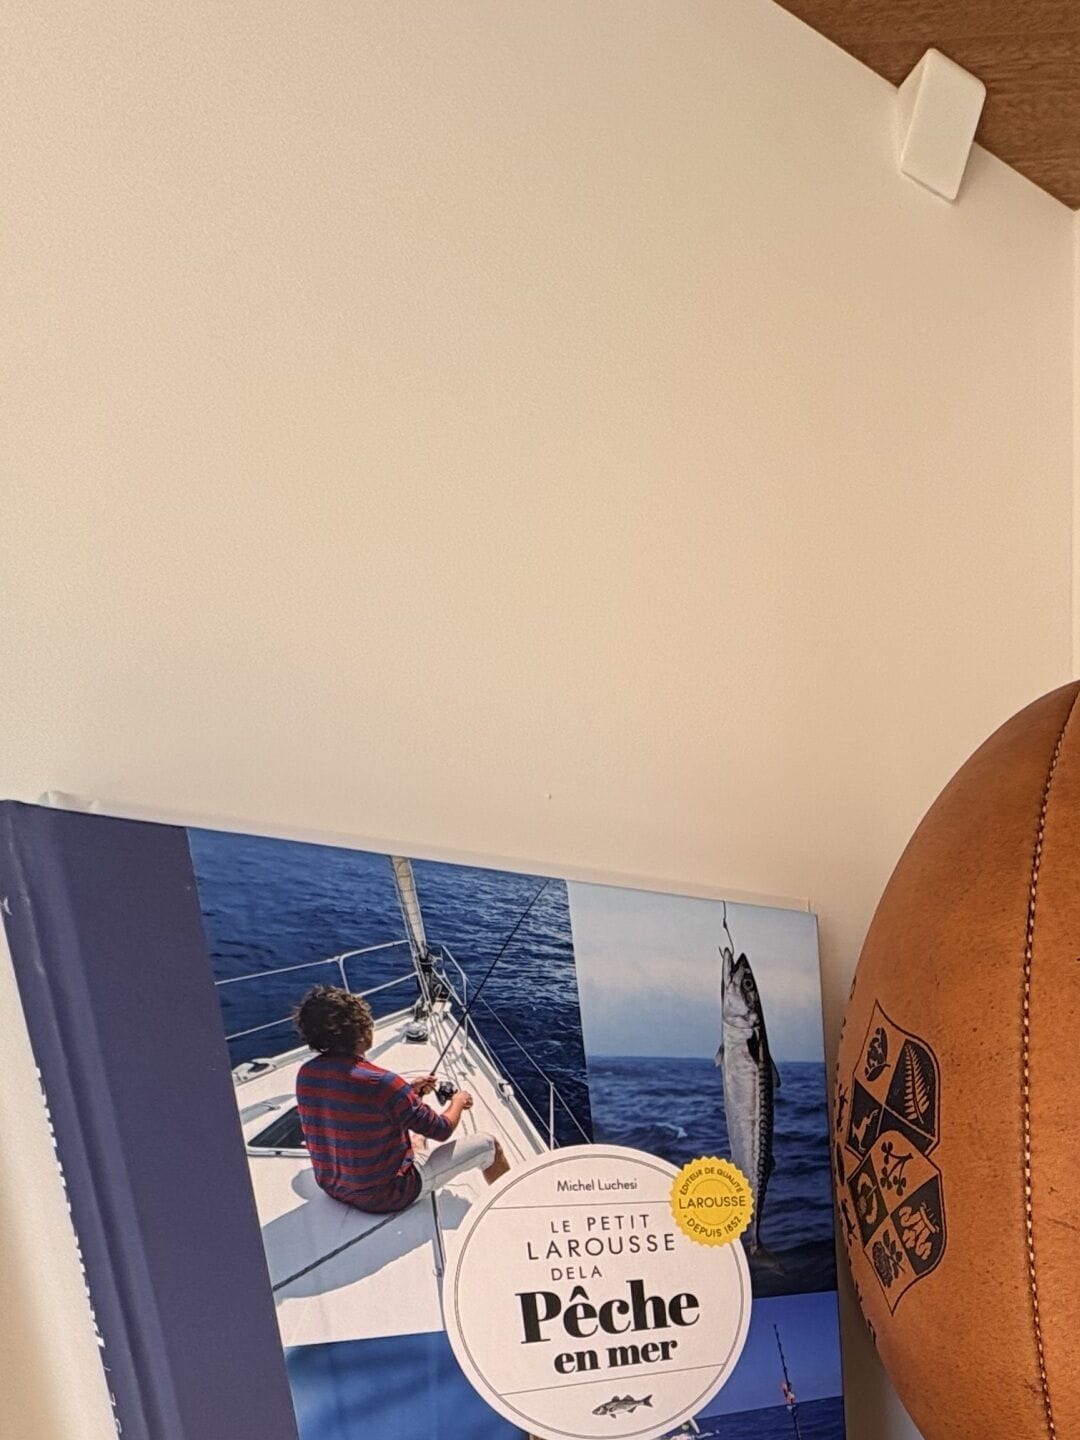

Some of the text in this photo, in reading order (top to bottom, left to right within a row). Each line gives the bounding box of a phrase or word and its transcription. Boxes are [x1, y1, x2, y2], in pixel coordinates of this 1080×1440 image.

[705, 1166, 715, 1175] DE
[556, 1178, 638, 1192] Michel Luchesi
[678, 1195, 747, 1210] LAROUSSE
[550, 1214, 650, 1234] LE PETIT
[686, 1215, 742, 1238] DEPUIS 1852
[527, 1233, 676, 1260] LAROUSSE
[515, 1279, 700, 1345] Pêche
[554, 1338, 678, 1374] en mer
